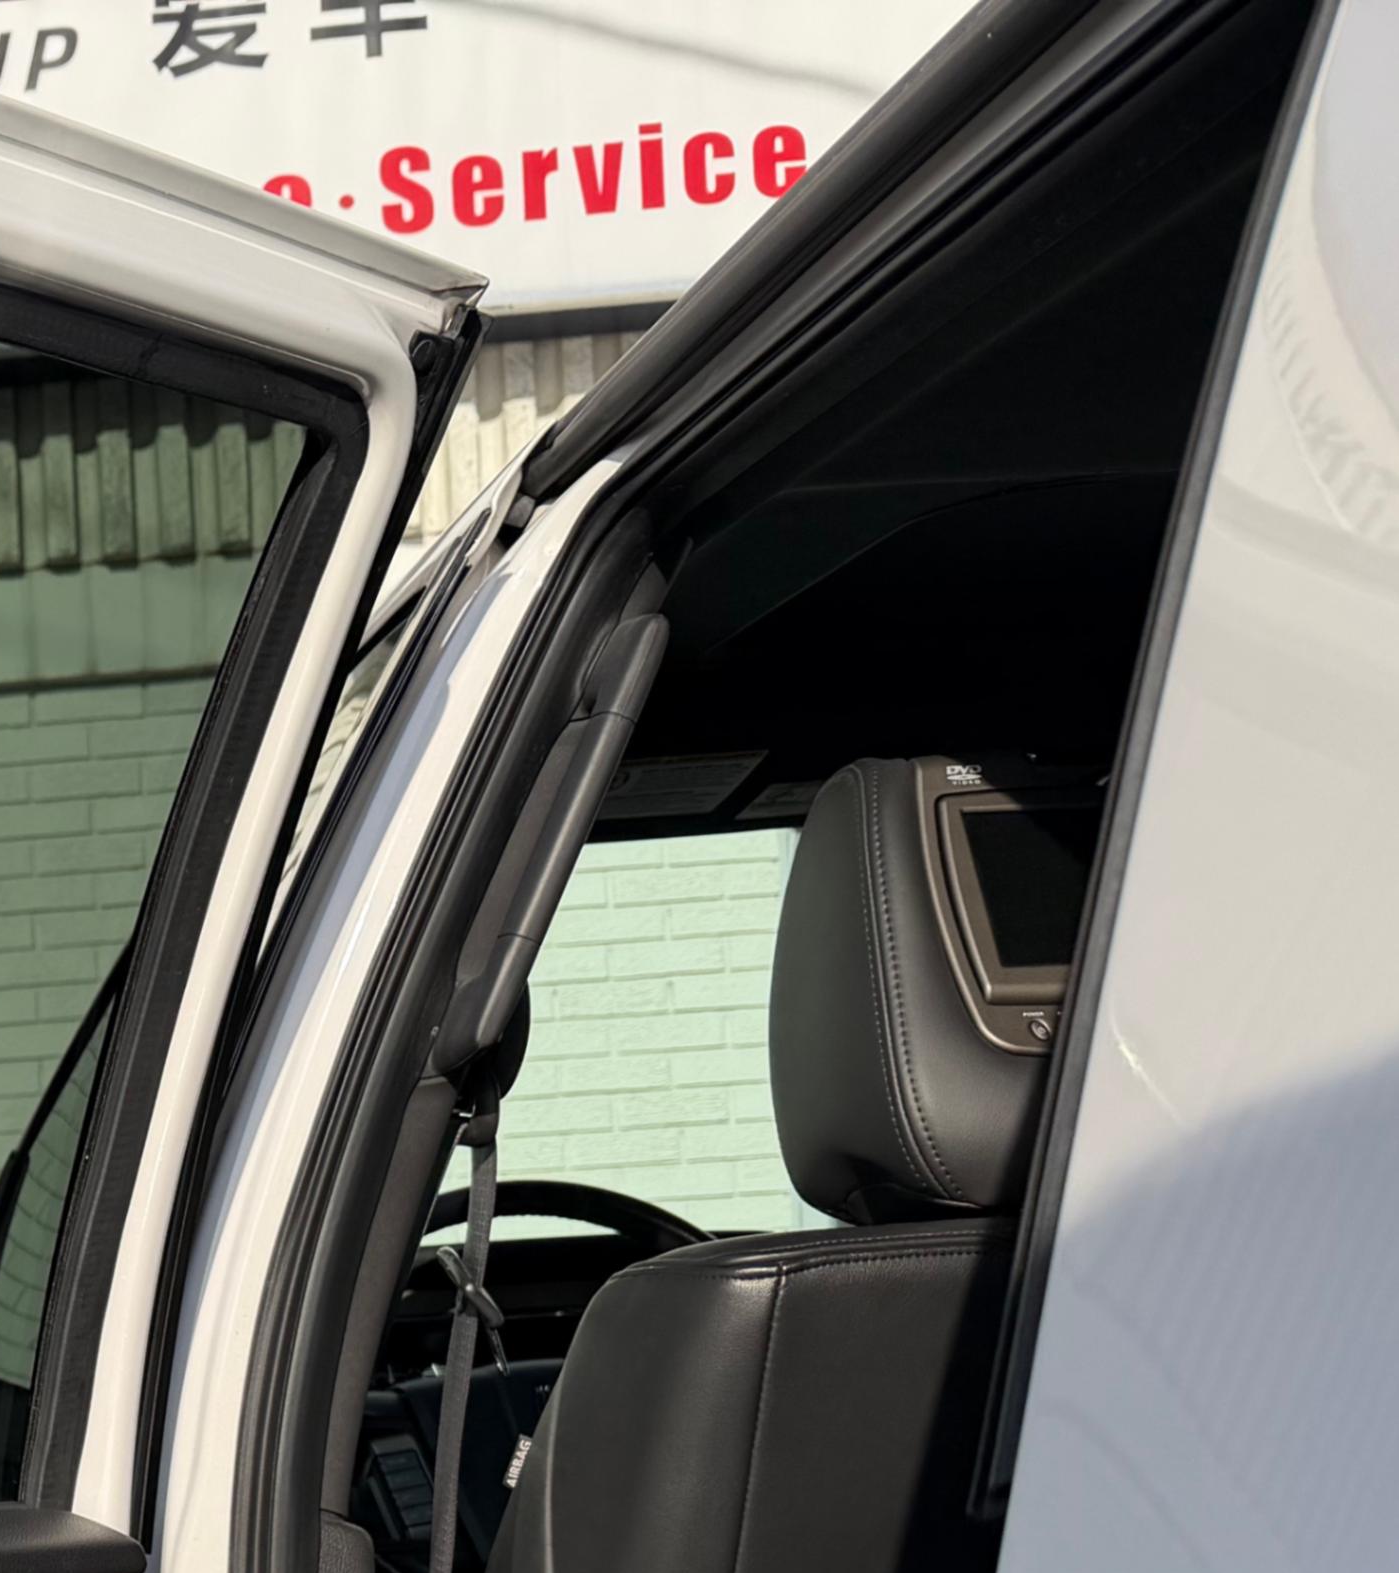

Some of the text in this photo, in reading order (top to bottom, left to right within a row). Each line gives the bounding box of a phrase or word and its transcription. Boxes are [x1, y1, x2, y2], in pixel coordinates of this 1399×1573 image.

[378, 122, 807, 234] Service
[946, 764, 982, 776] DVD
[505, 1438, 533, 1487] AIRBAG
